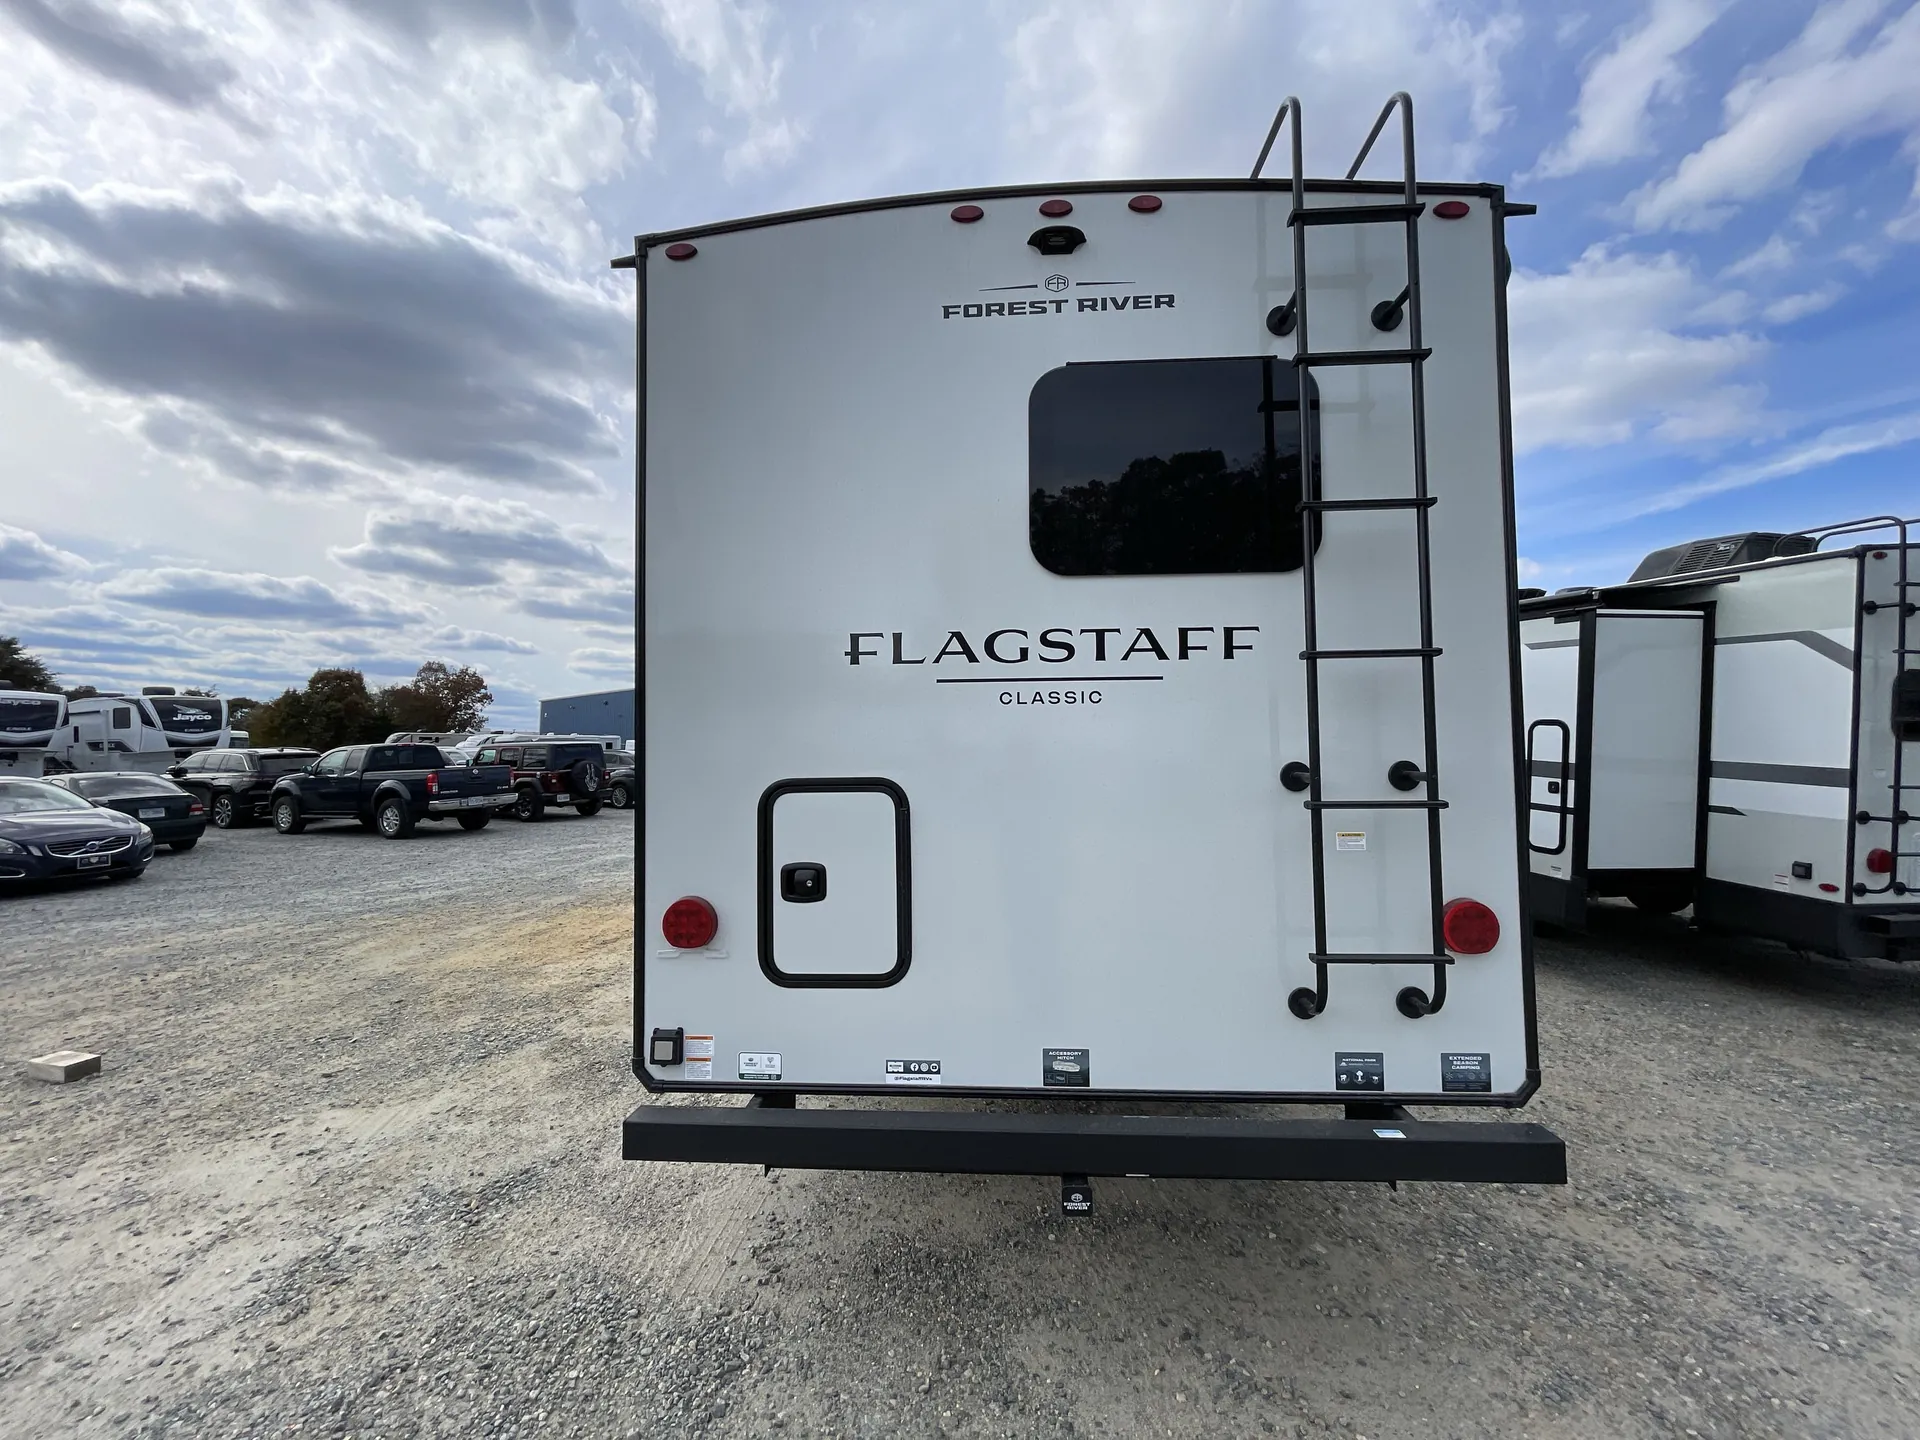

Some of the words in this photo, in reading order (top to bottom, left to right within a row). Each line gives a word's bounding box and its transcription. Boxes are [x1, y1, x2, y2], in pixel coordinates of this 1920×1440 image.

[942, 299, 1069, 319] FOREST
[1076, 294, 1176, 312] RIVER
[844, 626, 1261, 666] FLAGSTAFF
[999, 690, 1103, 706] CLASSIC
[173, 713, 212, 722] Jayco
